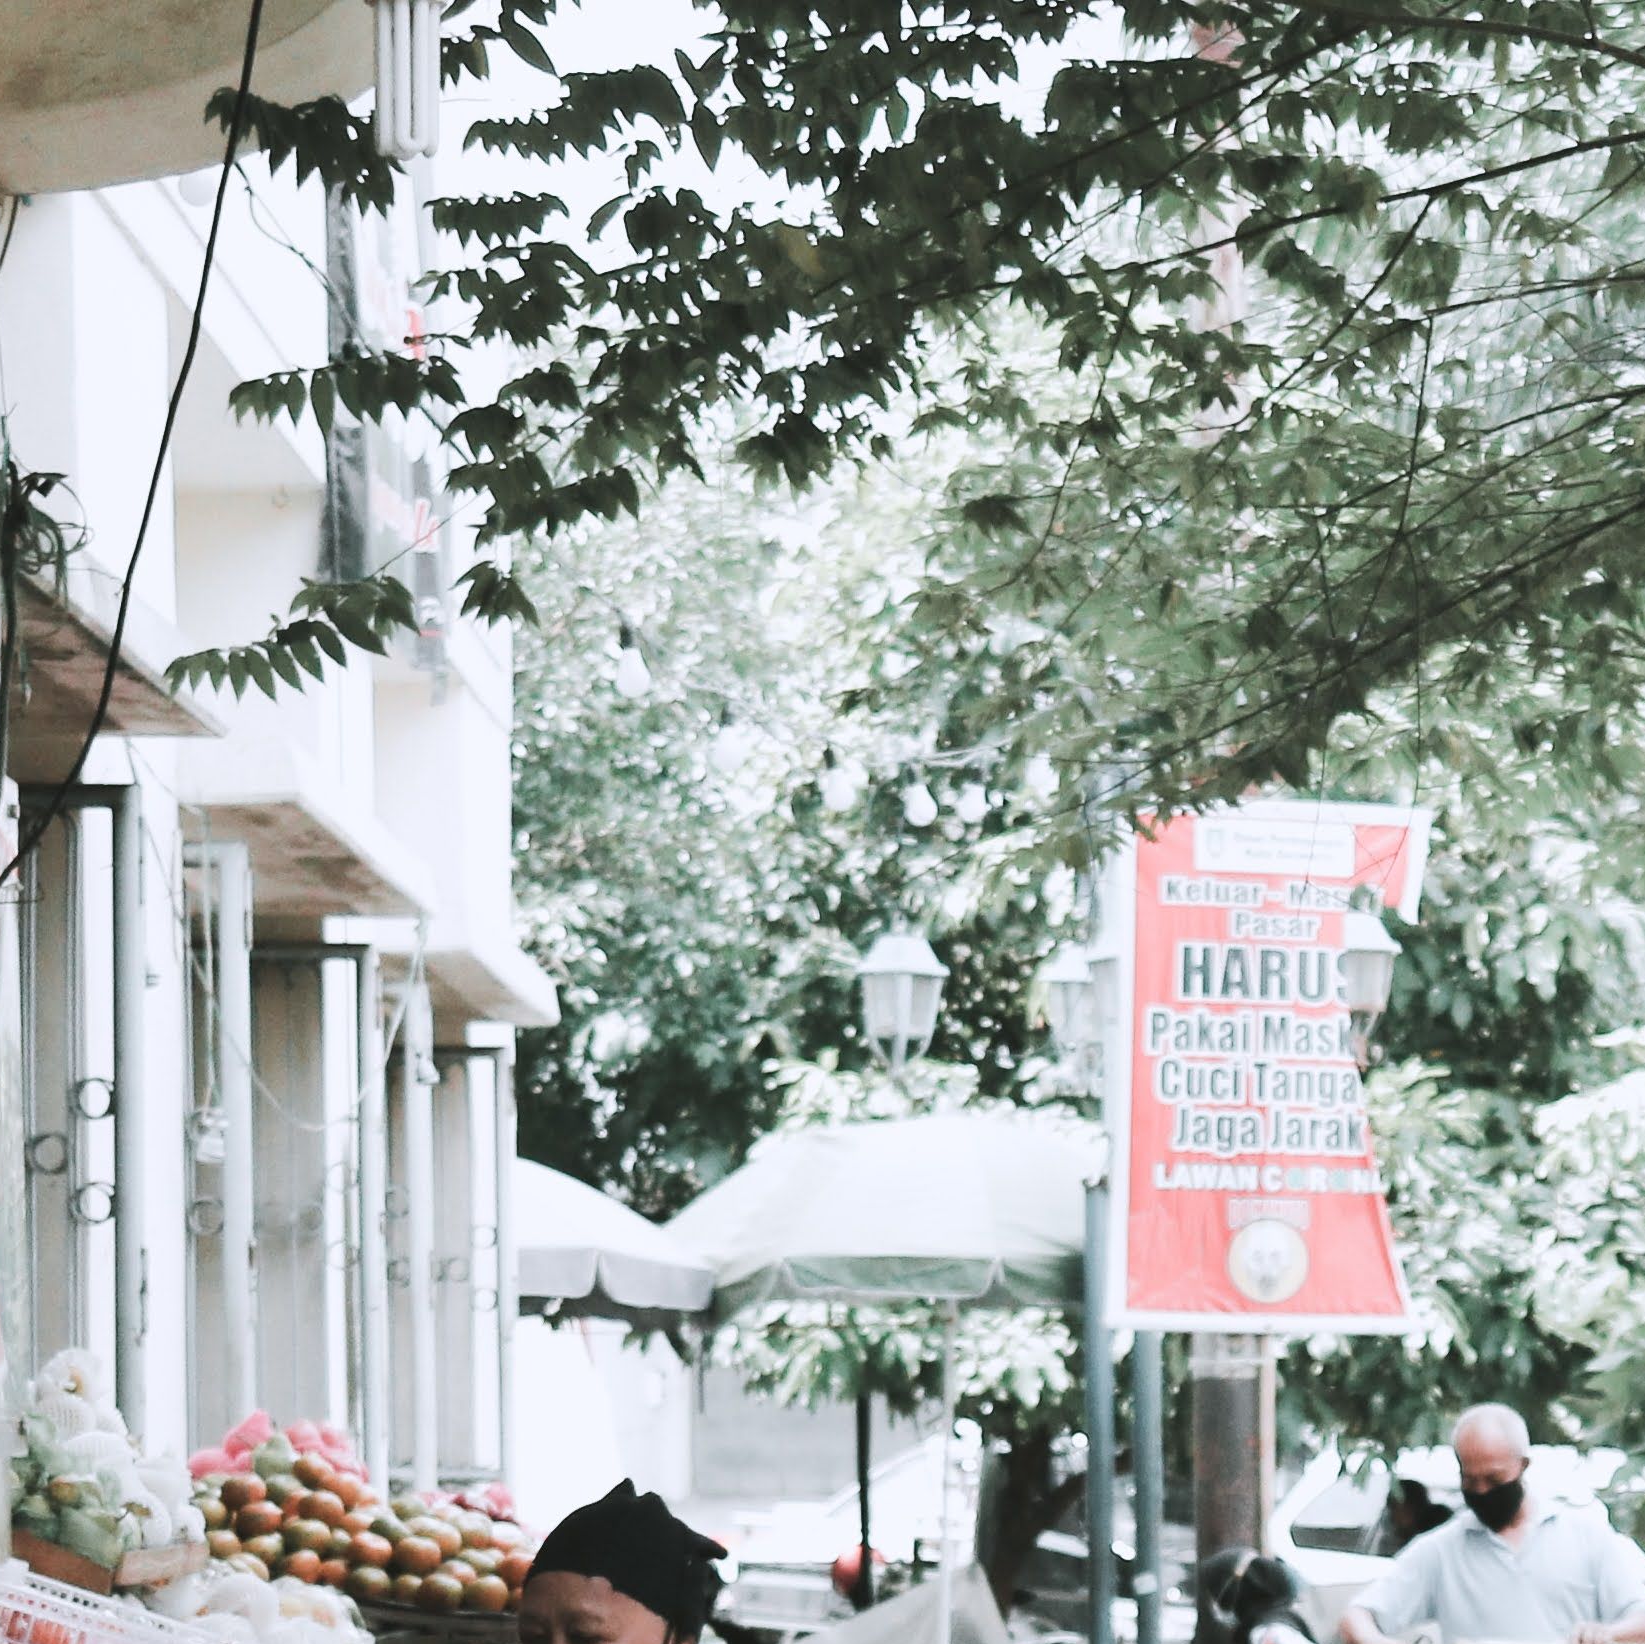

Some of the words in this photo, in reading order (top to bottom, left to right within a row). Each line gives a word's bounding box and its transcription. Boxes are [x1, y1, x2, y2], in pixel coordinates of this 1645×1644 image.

[1235, 911, 1317, 937] Pasar
[1152, 1012, 1249, 1051] Pakai
[1263, 1015, 1353, 1053] Mask
[1160, 1060, 1240, 1099] Cuci
[1254, 1063, 1360, 1106] Tanga
[1176, 1108, 1261, 1152] Jaga
[1270, 1110, 1365, 1150] Jarak
[1154, 1162, 1259, 1190] LAWAN
